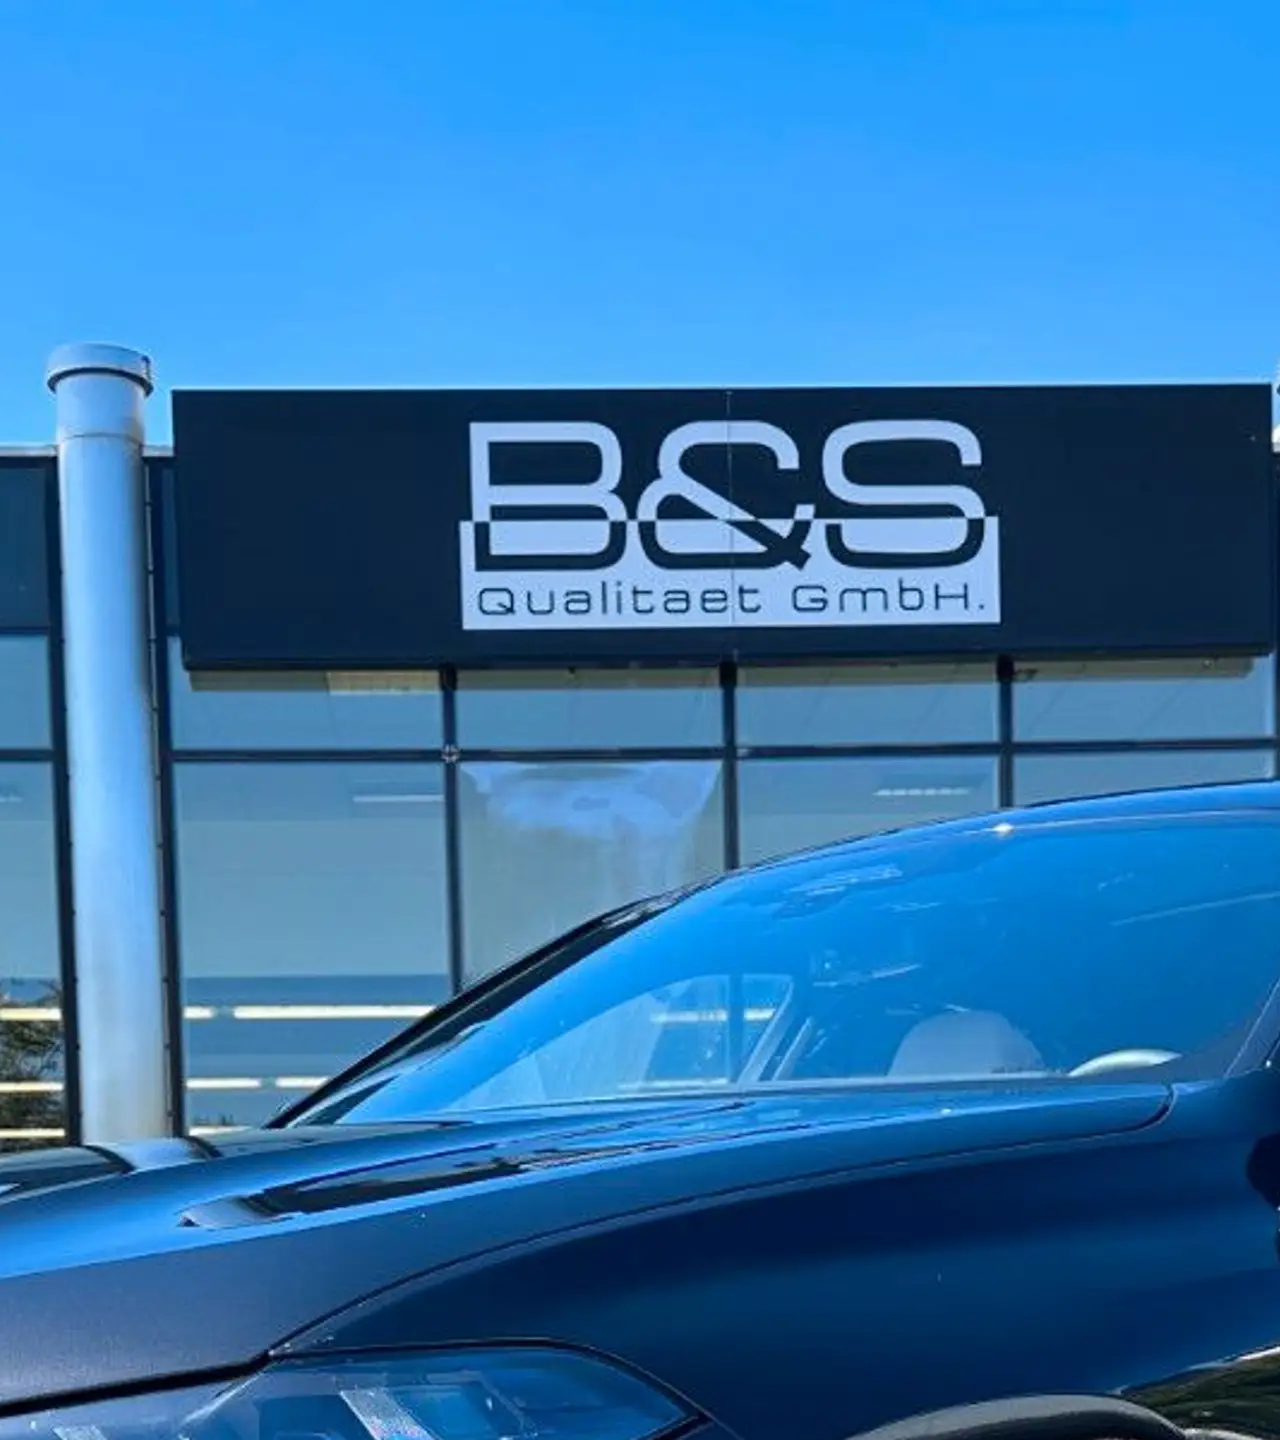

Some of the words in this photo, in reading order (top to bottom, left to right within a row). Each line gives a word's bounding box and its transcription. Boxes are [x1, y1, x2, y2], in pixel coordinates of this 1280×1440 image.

[469, 419, 986, 572] B&S
[477, 580, 763, 615] Qualitaet
[791, 577, 986, 613] GmbH.
